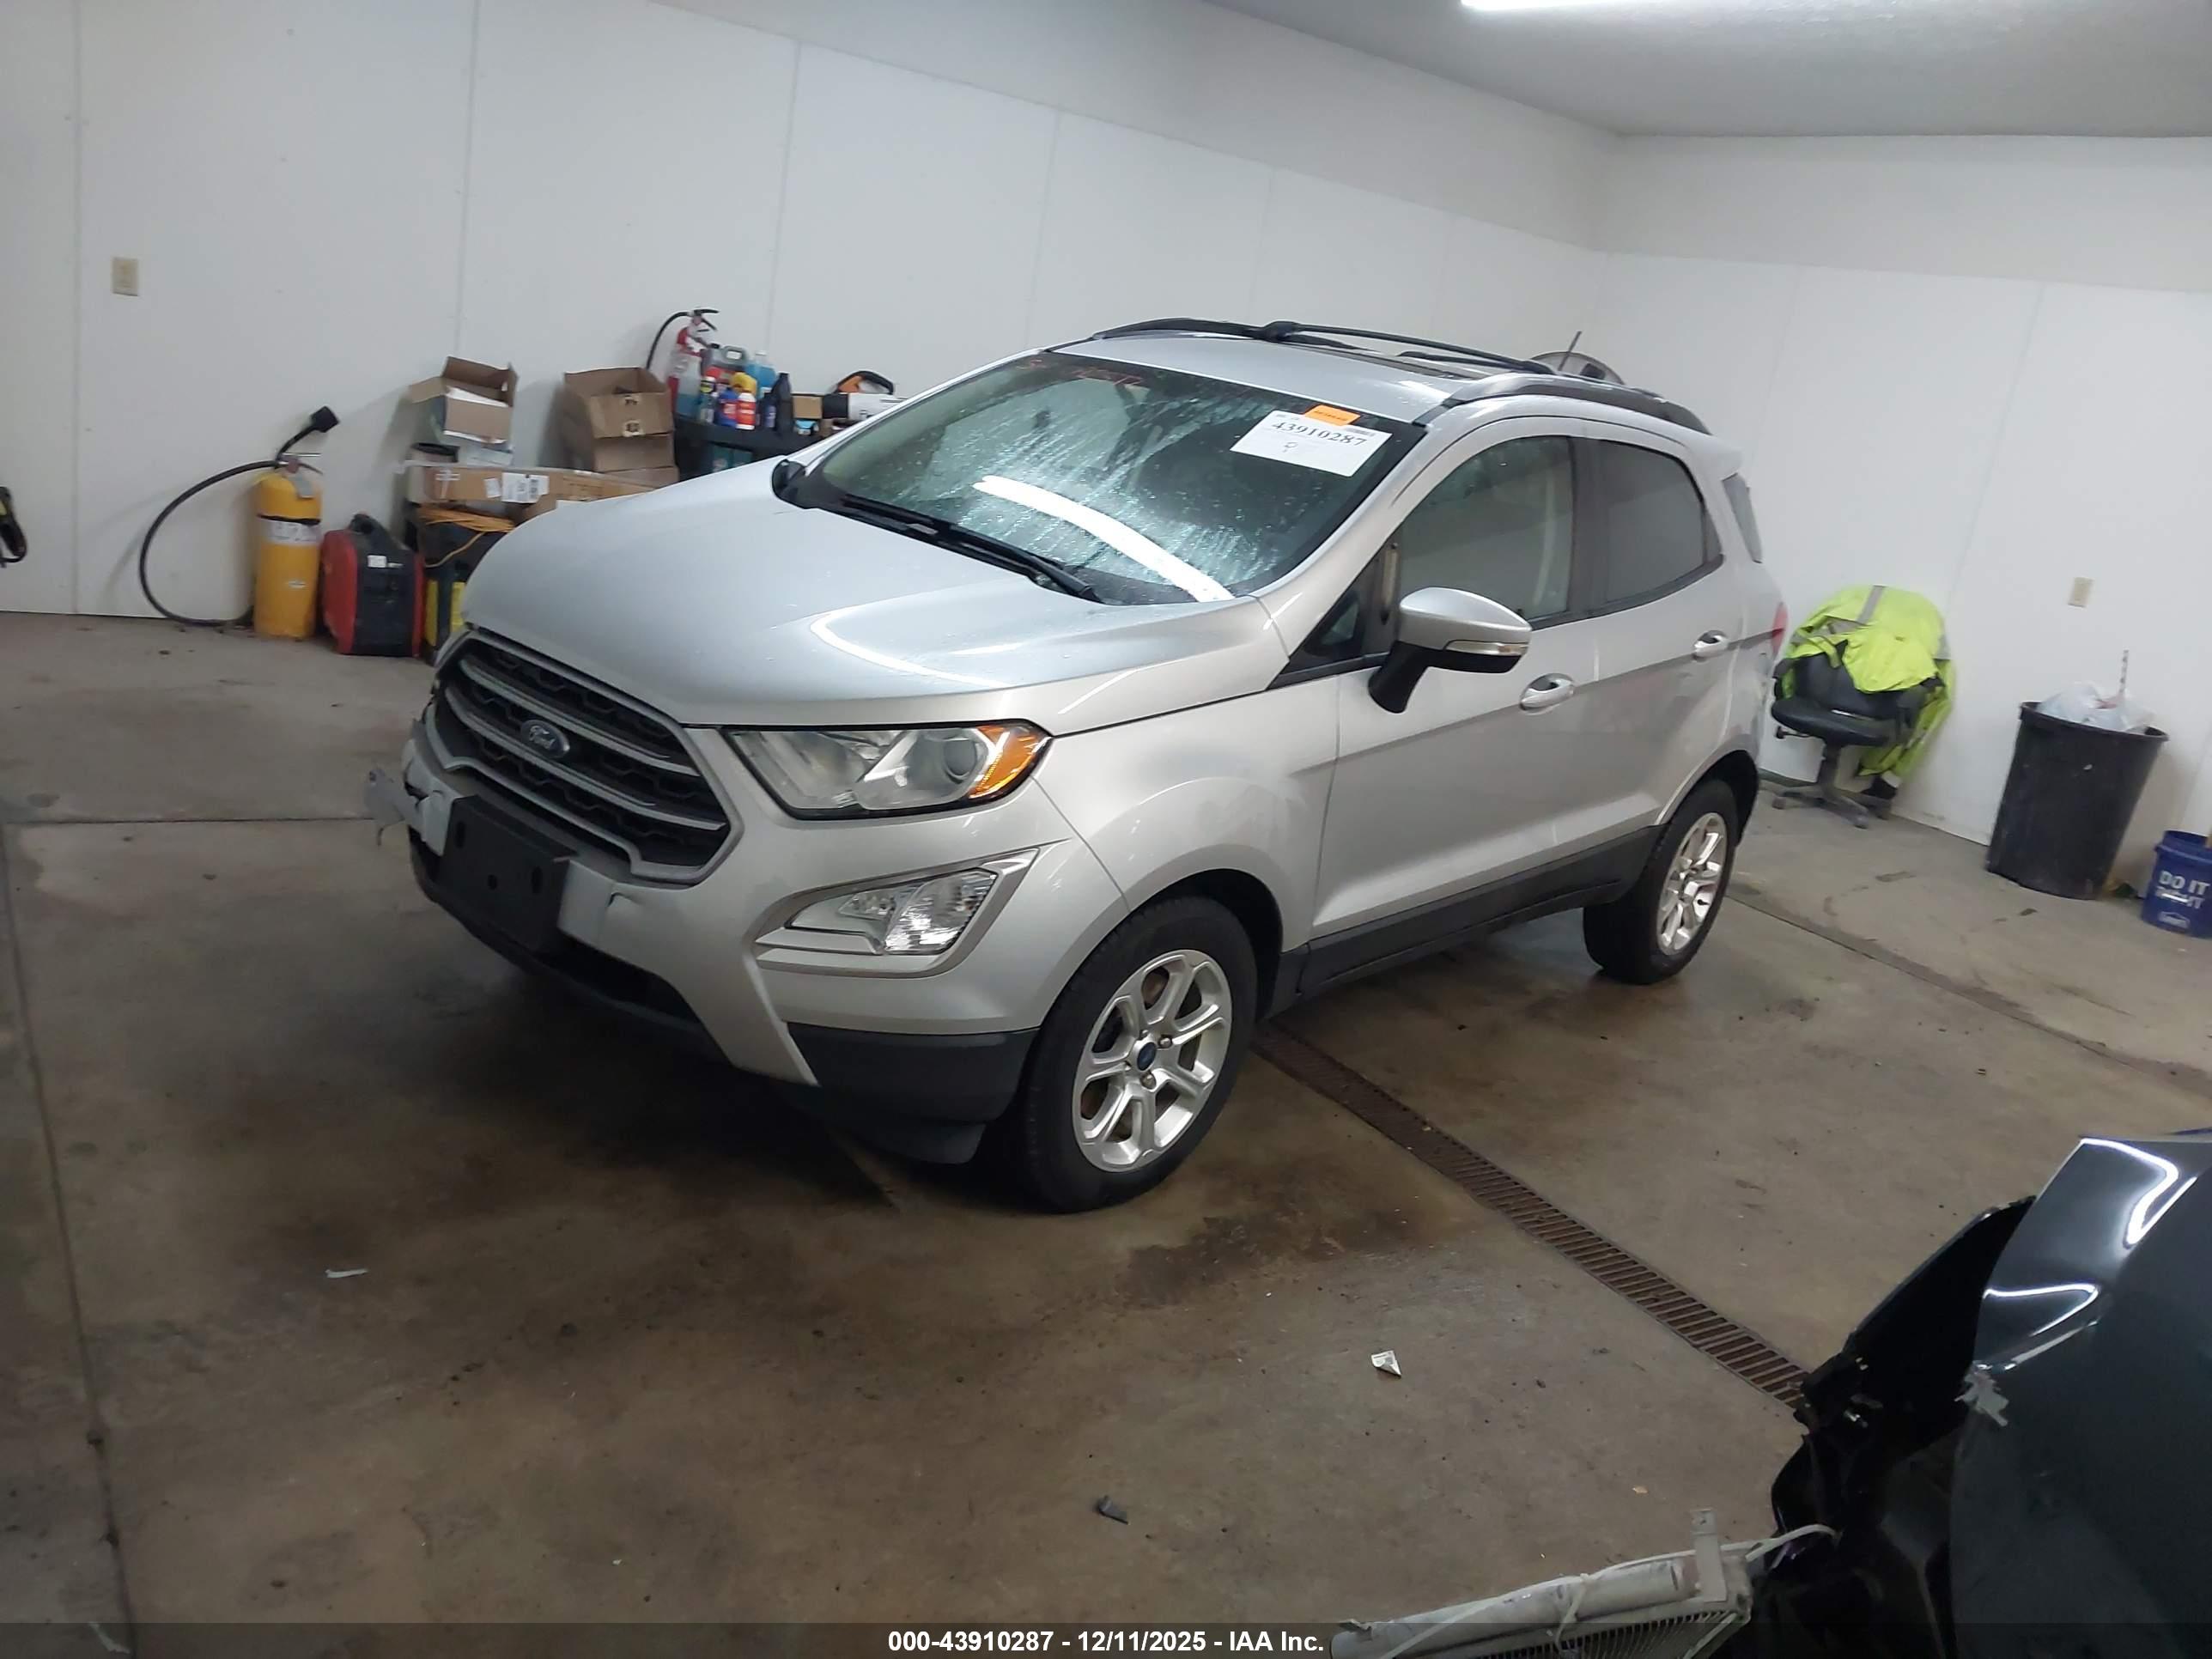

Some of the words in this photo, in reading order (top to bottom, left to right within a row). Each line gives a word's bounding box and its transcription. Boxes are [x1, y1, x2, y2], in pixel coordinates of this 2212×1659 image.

[1272, 421, 1368, 446] 43910287
[2158, 870, 2185, 890] DO
[2188, 879, 2211, 896] IT
